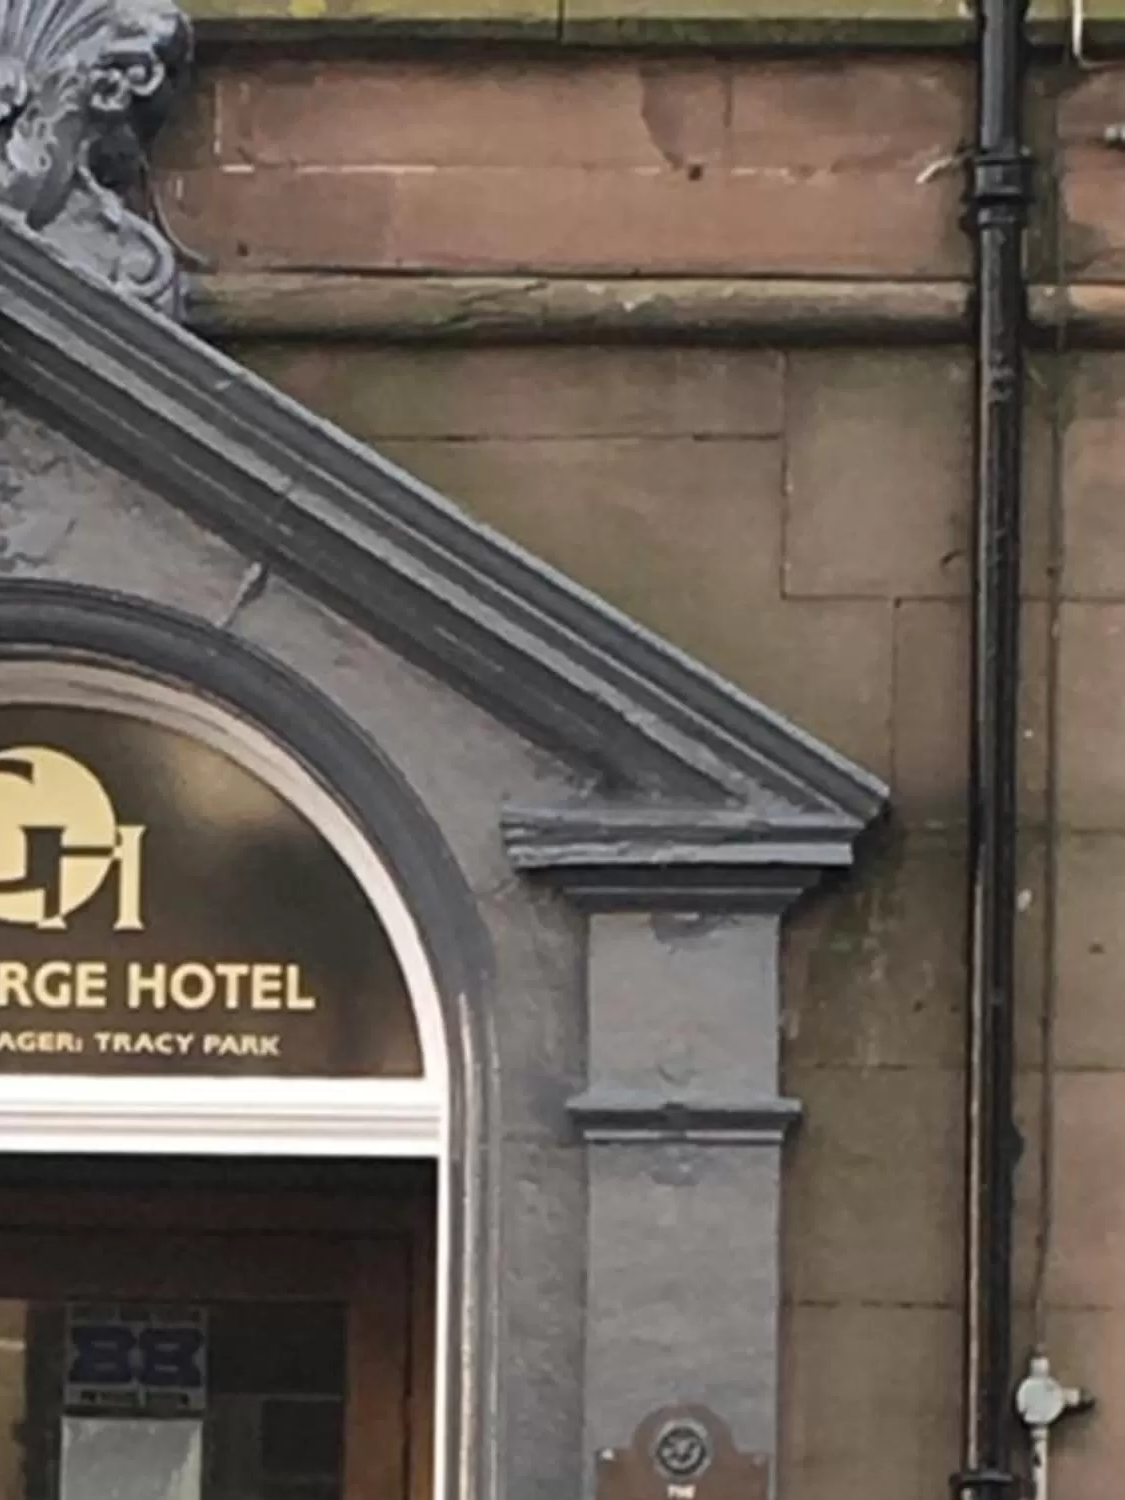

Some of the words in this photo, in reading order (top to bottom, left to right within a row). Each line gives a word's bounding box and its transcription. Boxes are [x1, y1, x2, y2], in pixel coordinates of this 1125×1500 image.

[128, 963, 315, 1010] HOTEL
[94, 1032, 195, 1055] TRACY
[204, 1034, 280, 1056] PARK
